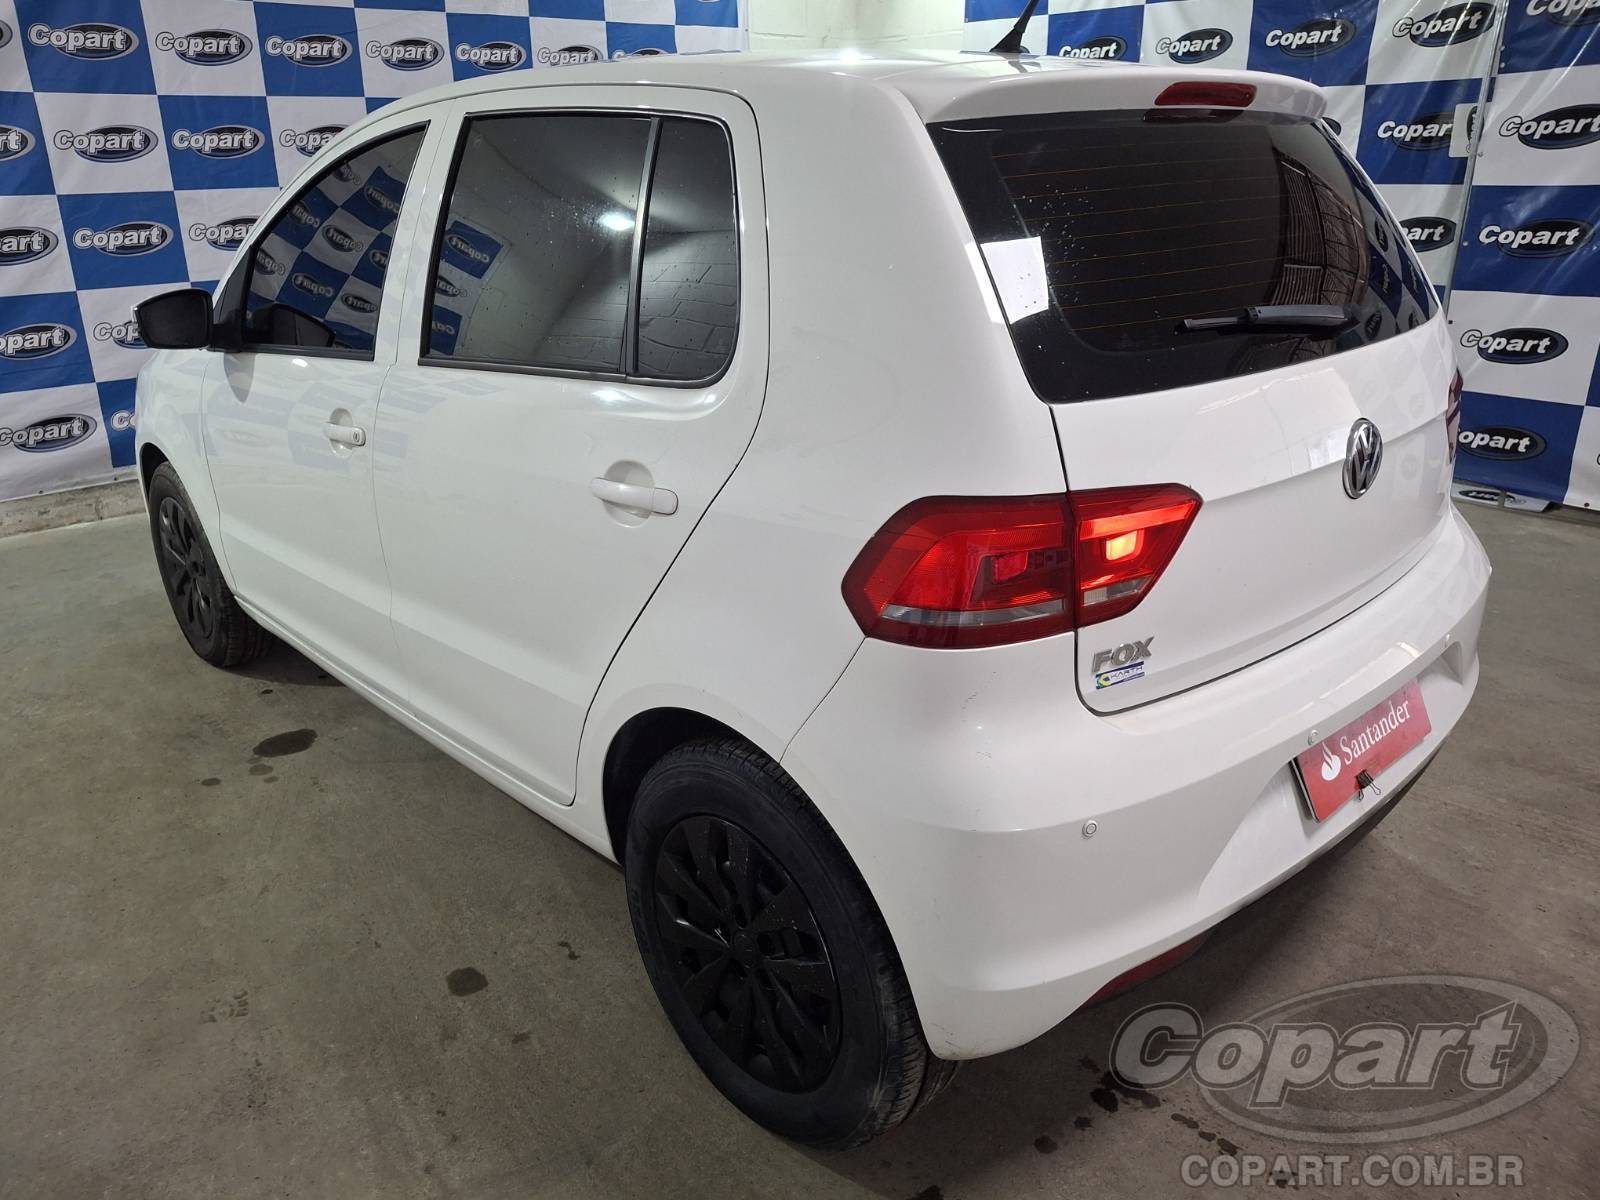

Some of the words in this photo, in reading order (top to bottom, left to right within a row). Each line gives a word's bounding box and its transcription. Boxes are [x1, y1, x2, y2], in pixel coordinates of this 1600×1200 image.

[1392, 11, 1482, 38] Copart
[29, 23, 128, 51] Copart
[155, 32, 241, 56] Copart
[265, 36, 344, 59] Copart
[1155, 34, 1222, 54] Copart
[1265, 25, 1342, 49] Copart
[366, 40, 435, 61] Copart
[455, 42, 519, 64] Copart
[537, 47, 595, 65] Copart
[1059, 43, 1117, 59] Copart
[54, 129, 145, 155] Copart
[172, 128, 255, 153] Copart
[73, 226, 161, 254] Copart
[1479, 225, 1580, 248] Copart
[1460, 329, 1550, 354] Copart
[0, 416, 84, 447] Copart
[1458, 430, 1530, 452] opart
[1092, 636, 1154, 673] FOX
[1340, 700, 1410, 766] Santander
